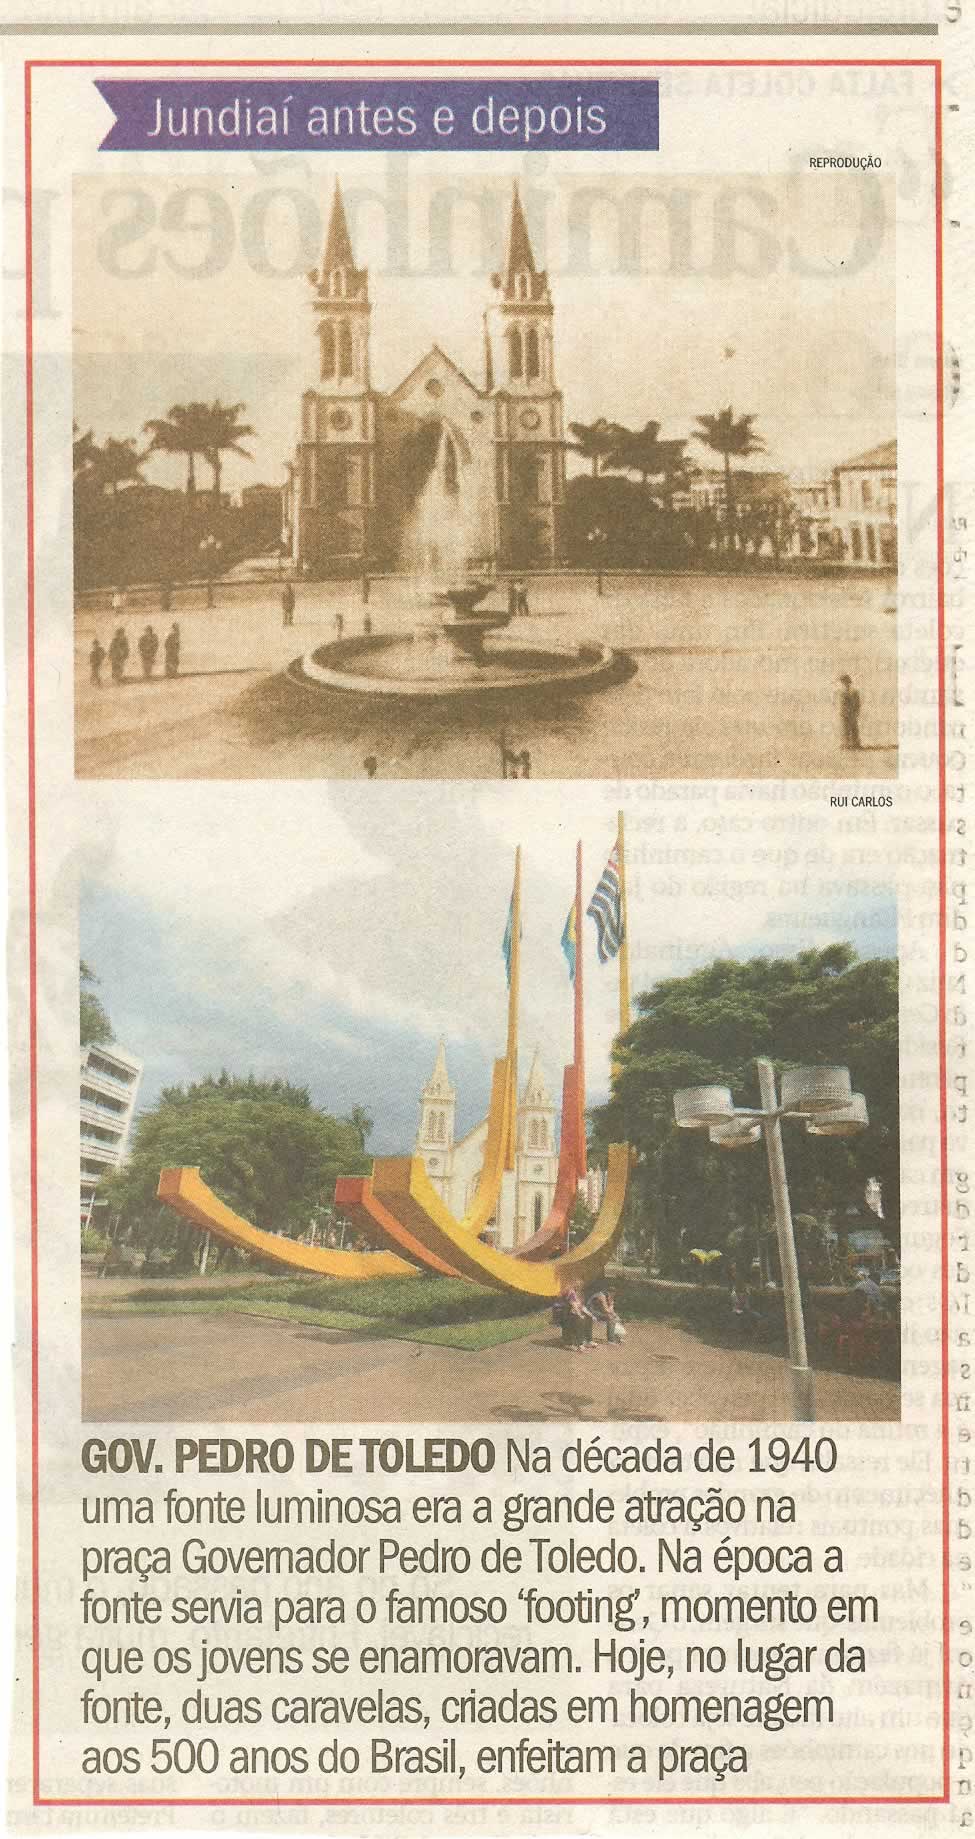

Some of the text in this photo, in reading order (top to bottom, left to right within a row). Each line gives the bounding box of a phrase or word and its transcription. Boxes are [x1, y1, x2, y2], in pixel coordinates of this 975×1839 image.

[147, 95, 607, 144] Jundiaí antes e depois
[809, 155, 882, 171] REPRODUÇÃO
[830, 796, 893, 808] RUI CARLOS
[81, 1435, 838, 1474] GOV. PEDRO DE TOLEDO Na década de 1940
[82, 1487, 796, 1529] uma fonte luminosa era a grande atração na
[82, 1535, 844, 1582] praça Governador Pedro de Toledo. Na época a
[79, 1588, 163, 1625] fonte
[171, 1588, 263, 1624] servia
[274, 1596, 346, 1629] para
[356, 1596, 377, 1624] o
[385, 1588, 508, 1624] famoso
[661, 1590, 817, 1624] momento
[827, 1595, 879, 1624] em
[81, 1637, 866, 1682] que os jovens se enamoravam. Hoje, no lugar da
[80, 1688, 834, 1730] fonte, duas caravelas, criadas em homenagem
[82, 1747, 141, 1774] aos
[150, 1738, 219, 1774] 500
[229, 1746, 309, 1774] anos
[318, 1738, 360, 1774] do
[371, 1738, 466, 1780] Brasil,
[476, 1737, 616, 1774] enfeitam
[627, 1746, 647, 1774] a
[658, 1745, 748, 1782] praça
